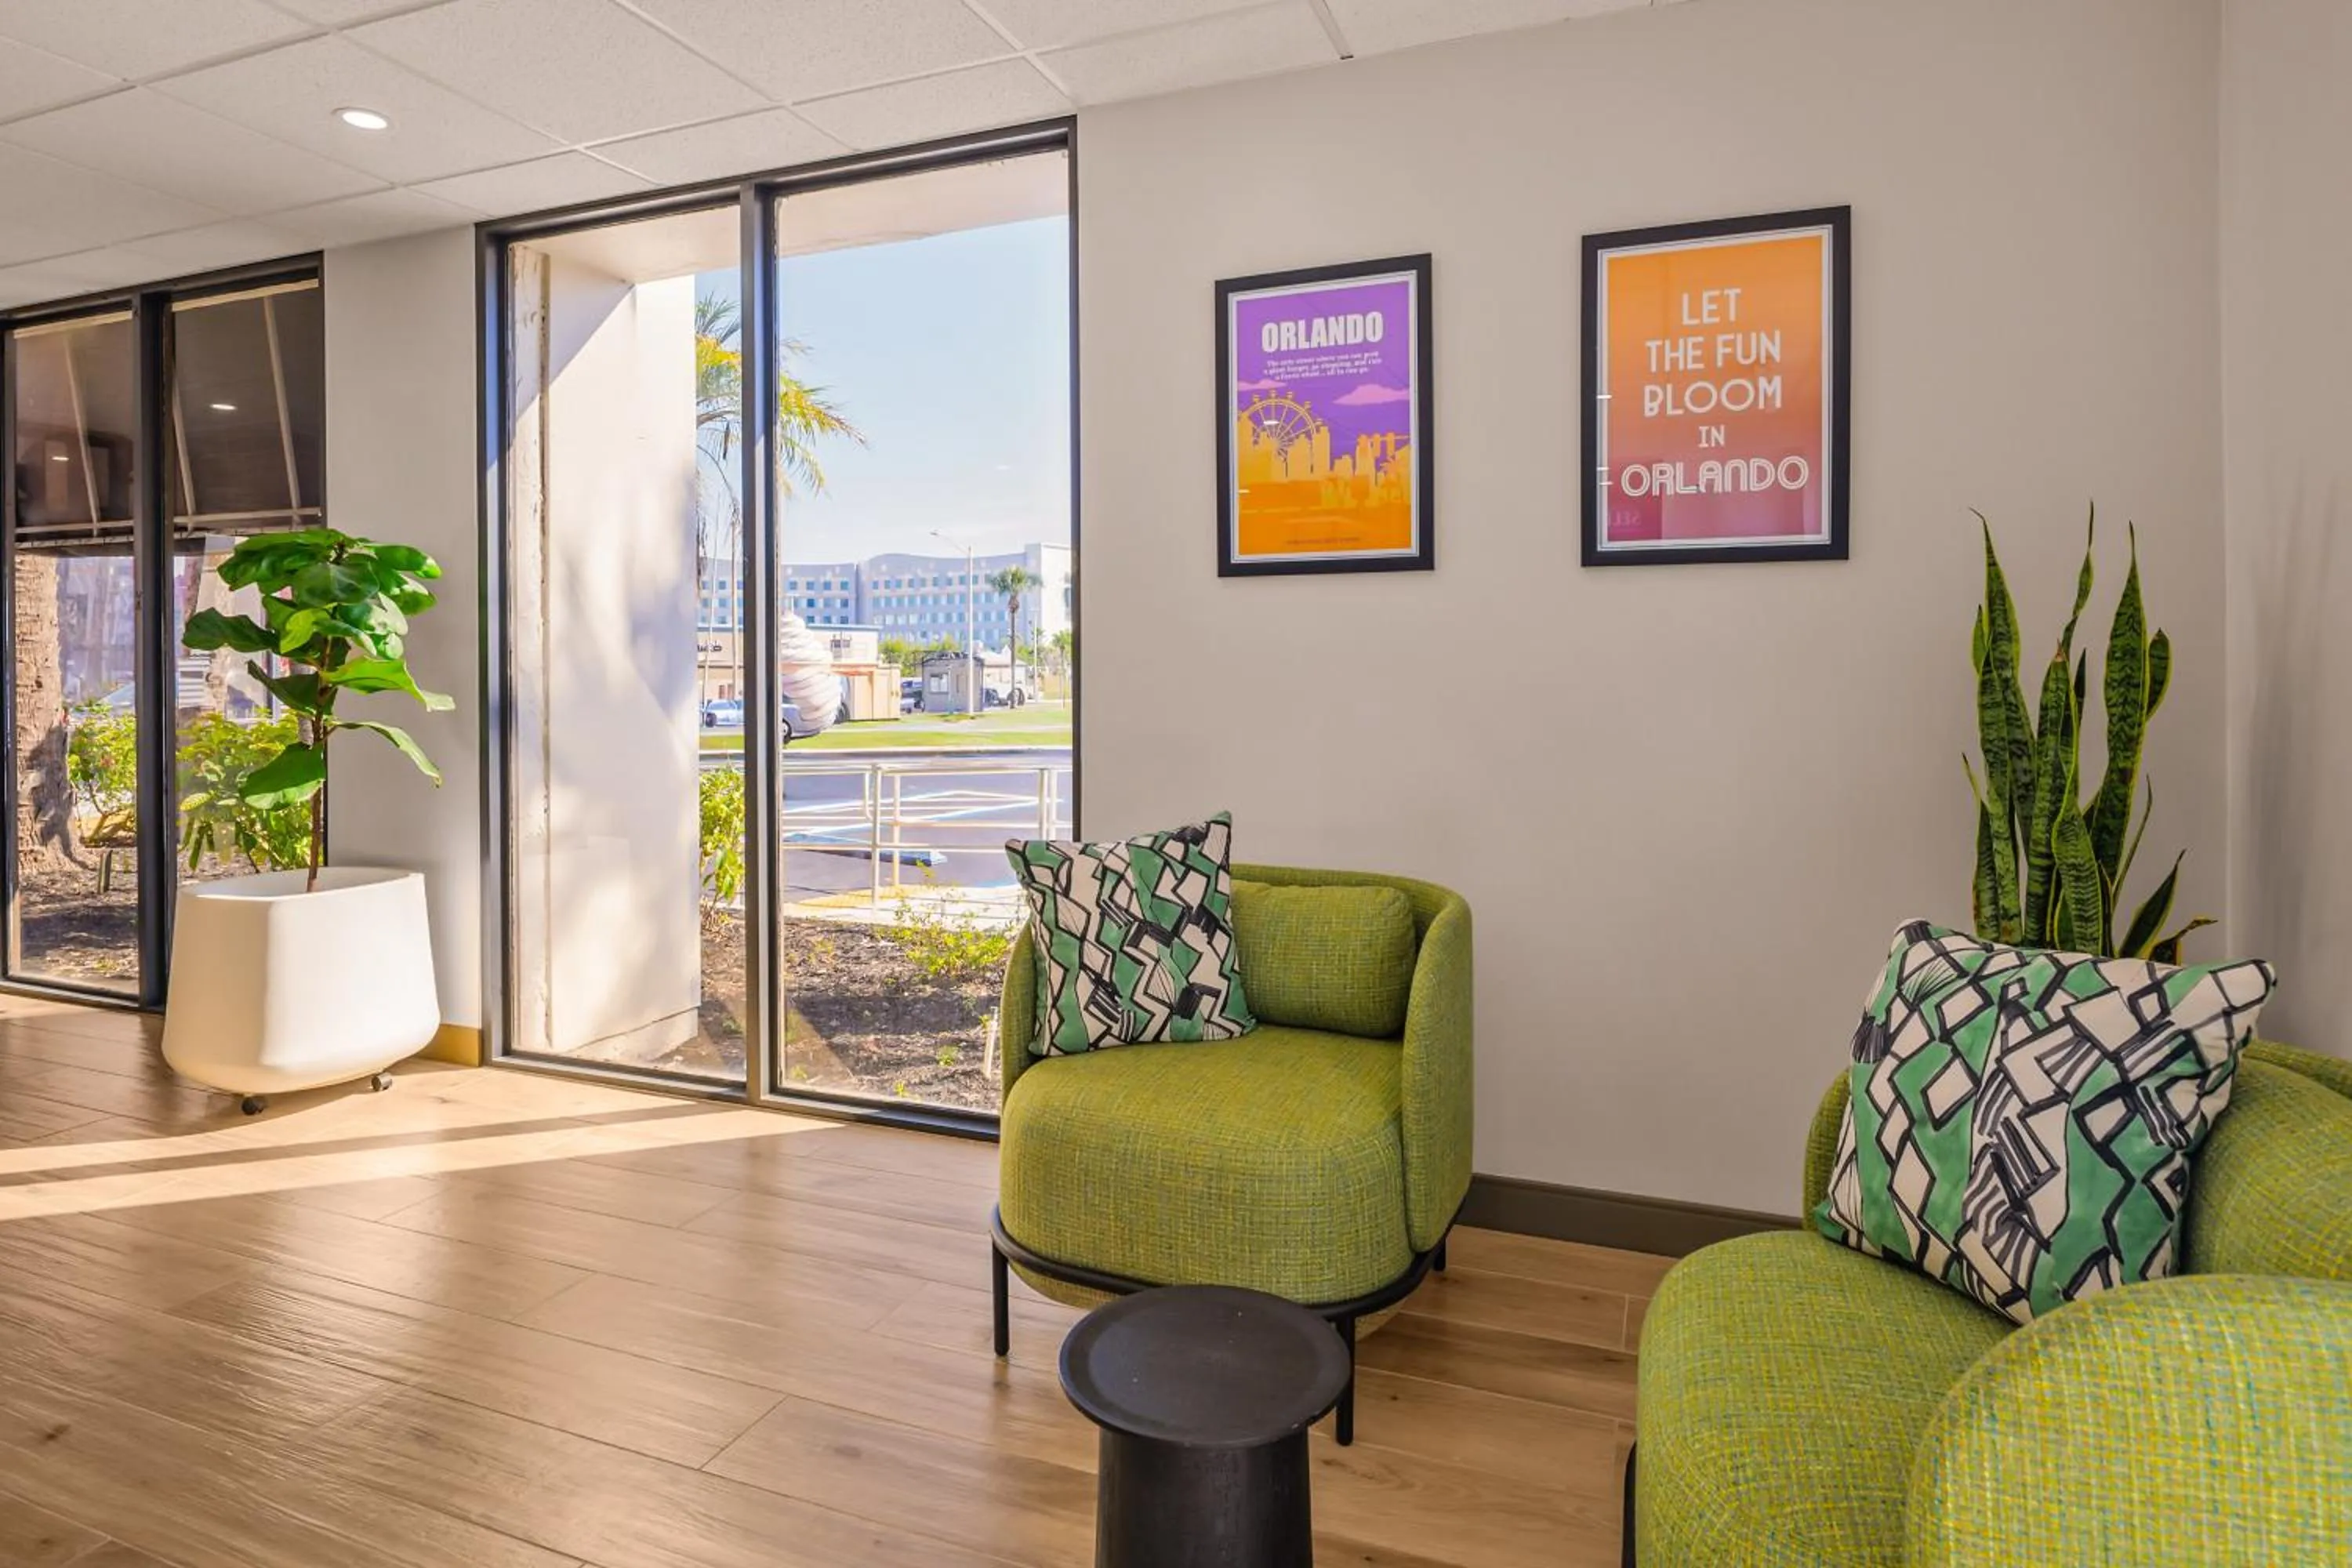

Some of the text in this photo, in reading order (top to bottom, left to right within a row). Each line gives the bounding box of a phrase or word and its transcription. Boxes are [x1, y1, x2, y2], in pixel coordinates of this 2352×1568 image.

[1681, 288, 1741, 326] LET
[1261, 311, 1384, 353] ORLANDO
[1645, 329, 1780, 374] THE FUN
[1643, 375, 1782, 417] BLOOM
[1697, 425, 1725, 448] IN
[1621, 456, 1809, 497] ORLANDO
